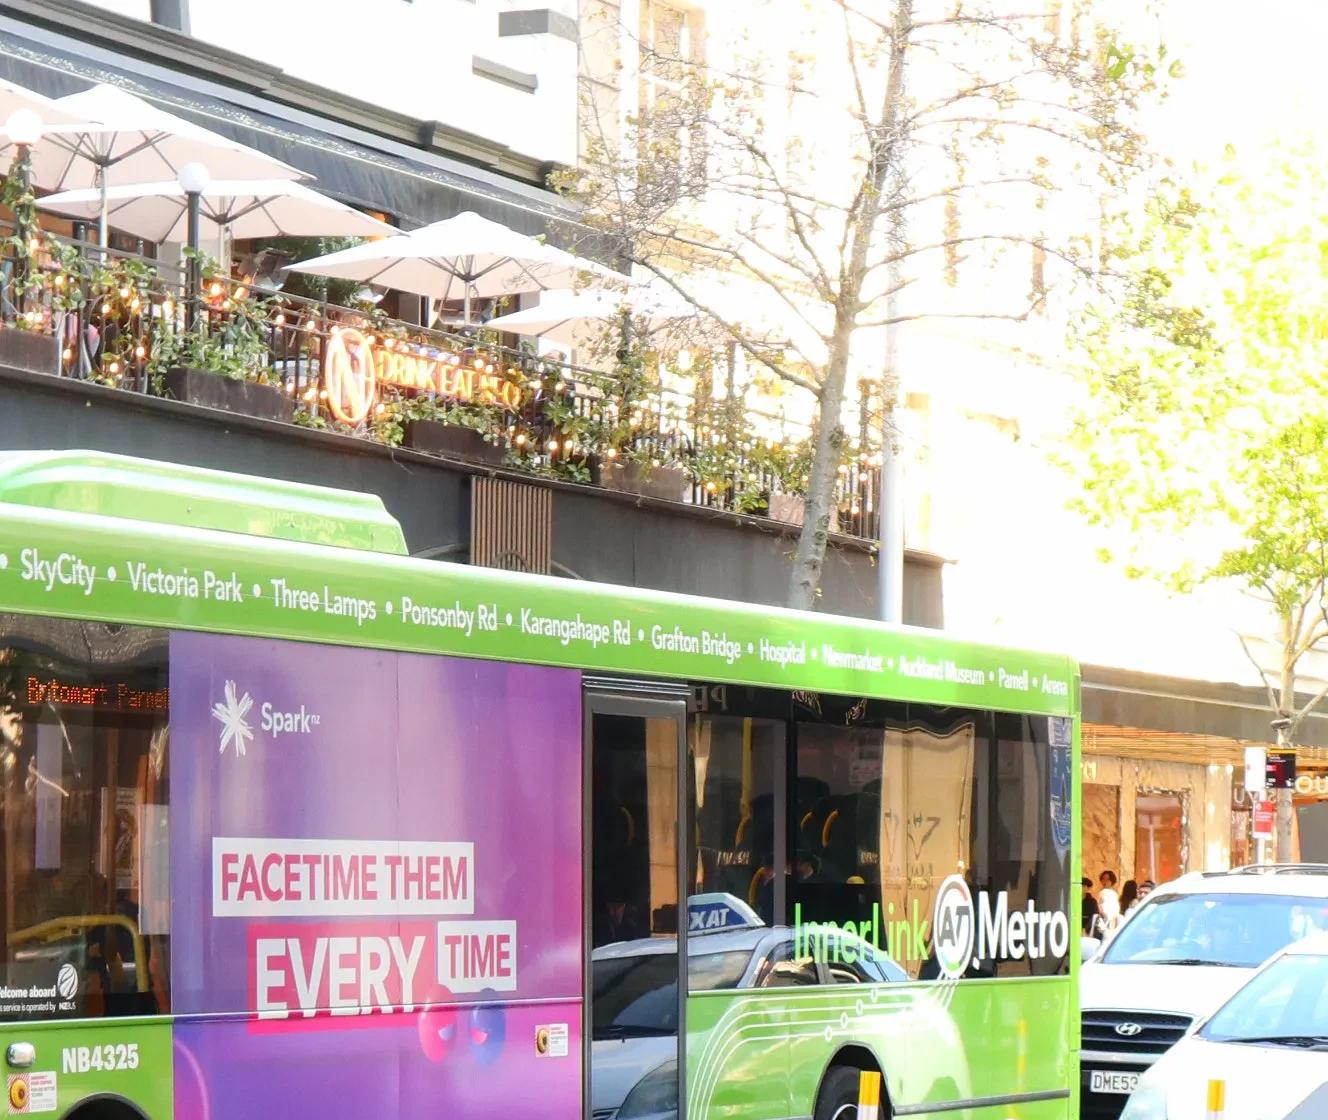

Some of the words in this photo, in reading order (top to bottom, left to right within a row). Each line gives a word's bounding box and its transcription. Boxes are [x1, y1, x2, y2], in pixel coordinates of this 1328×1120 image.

[378, 350, 436, 391] DRINK
[440, 363, 474, 398] EAT
[20, 551, 97, 597] SkyCity
[126, 560, 199, 599] Victoria
[203, 572, 244, 602] Park
[271, 578, 320, 613] Three
[323, 585, 377, 626] Lamps
[401, 596, 476, 638] Ponsonby
[478, 603, 498, 632] Rd
[520, 608, 610, 649] Karangahape
[612, 618, 631, 646] Rd
[651, 625, 700, 655] Grafton
[702, 632, 742, 665] Bridge
[759, 638, 806, 670] Hospital
[822, 644, 883, 673] Newmarket
[898, 653, 944, 679] Auckland
[945, 659, 985, 686] Museum
[998, 667, 1029, 690] Parnell
[1041, 674, 1069, 696] Arena
[260, 702, 312, 738] Spark
[311, 713, 321, 725] nz
[220, 852, 378, 903] FACETIME
[385, 854, 468, 901] THEM
[978, 891, 1069, 960] Metro
[256, 935, 427, 1020] EVERY
[443, 933, 512, 981] TIME
[3, 1003, 21, 1012] service
[25, 1002, 50, 1013] operated
[49, 1002, 57, 1012] by
[29, 985, 57, 998] aboard
[62, 1044, 139, 1074] NB4325
[1094, 1074, 1139, 1091] DME53
